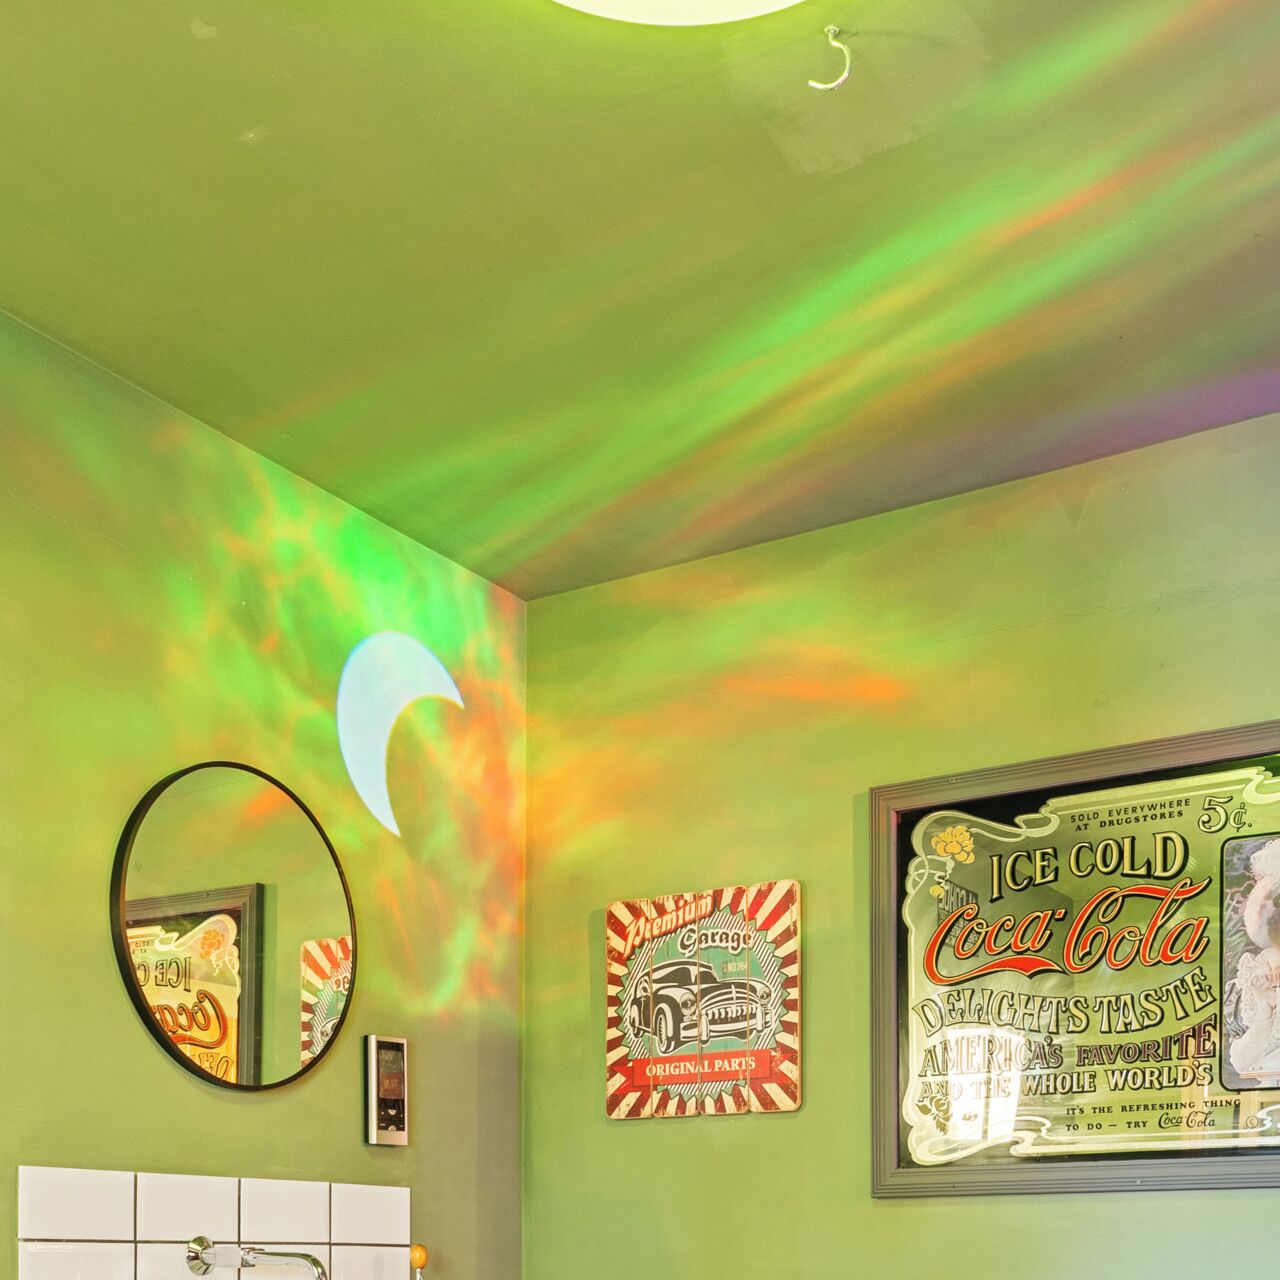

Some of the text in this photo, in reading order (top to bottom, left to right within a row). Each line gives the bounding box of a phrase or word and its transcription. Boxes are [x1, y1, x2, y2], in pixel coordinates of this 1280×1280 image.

[1070, 798, 1191, 823] SOLD EVERYWHERE
[1075, 810, 1184, 832] AT DRUGSTORES
[989, 831, 1190, 903] ICE COLD
[624, 895, 714, 958] Premium
[678, 926, 753, 957] Garage
[911, 966, 1218, 1038] DELIGHTS TASTE
[918, 1014, 1219, 1077] AMERICA'S FAVORITE
[646, 1057, 756, 1077] ORIGINAL PARTS
[1022, 1070, 1096, 1097] WHOLE
[1108, 1061, 1213, 1092] WORLD'S
[1066, 1099, 1241, 1115] IT'S THE REFRESHING THING
[1065, 1123, 1079, 1132] TO
[1087, 1122, 1102, 1130] DO
[1126, 1120, 1149, 1129] TRY
